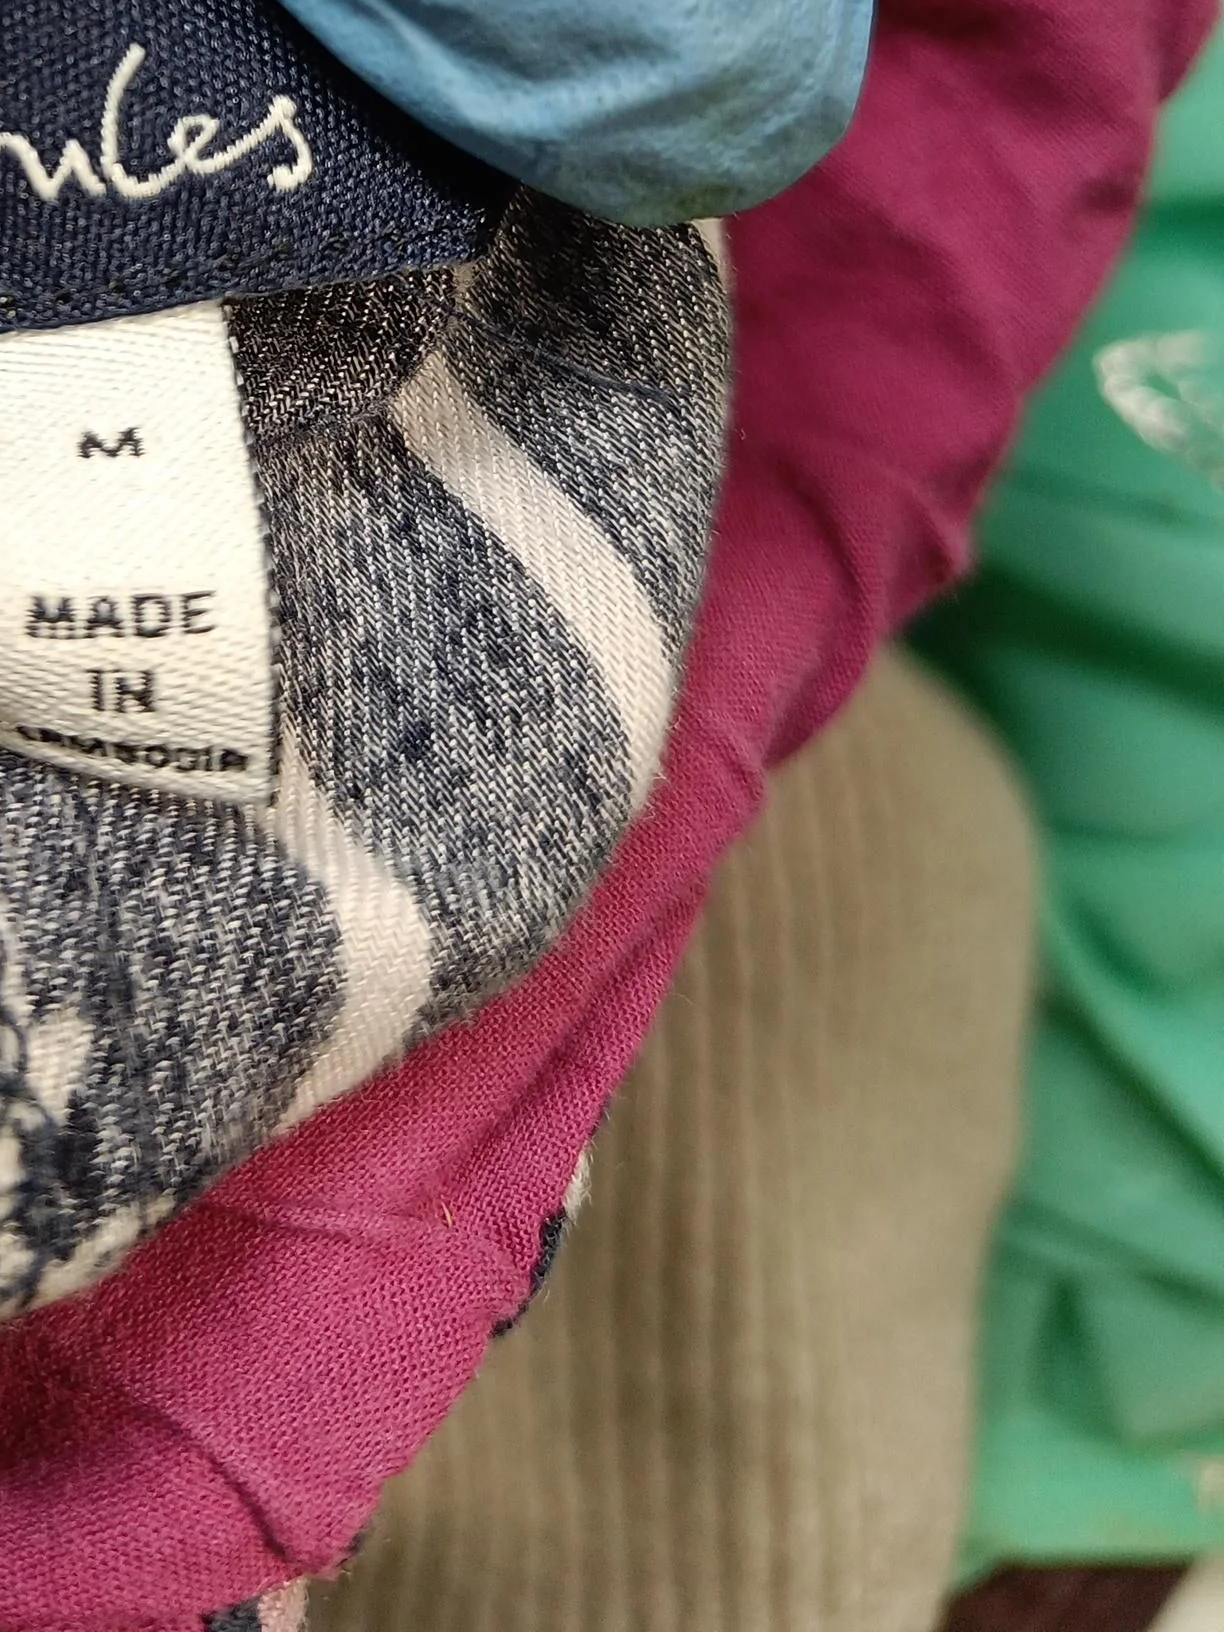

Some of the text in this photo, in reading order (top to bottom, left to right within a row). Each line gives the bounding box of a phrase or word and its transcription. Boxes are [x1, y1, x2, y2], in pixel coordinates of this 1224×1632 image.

[78, 426, 144, 459] M
[25, 591, 216, 639] MADE
[87, 670, 155, 714] IN
